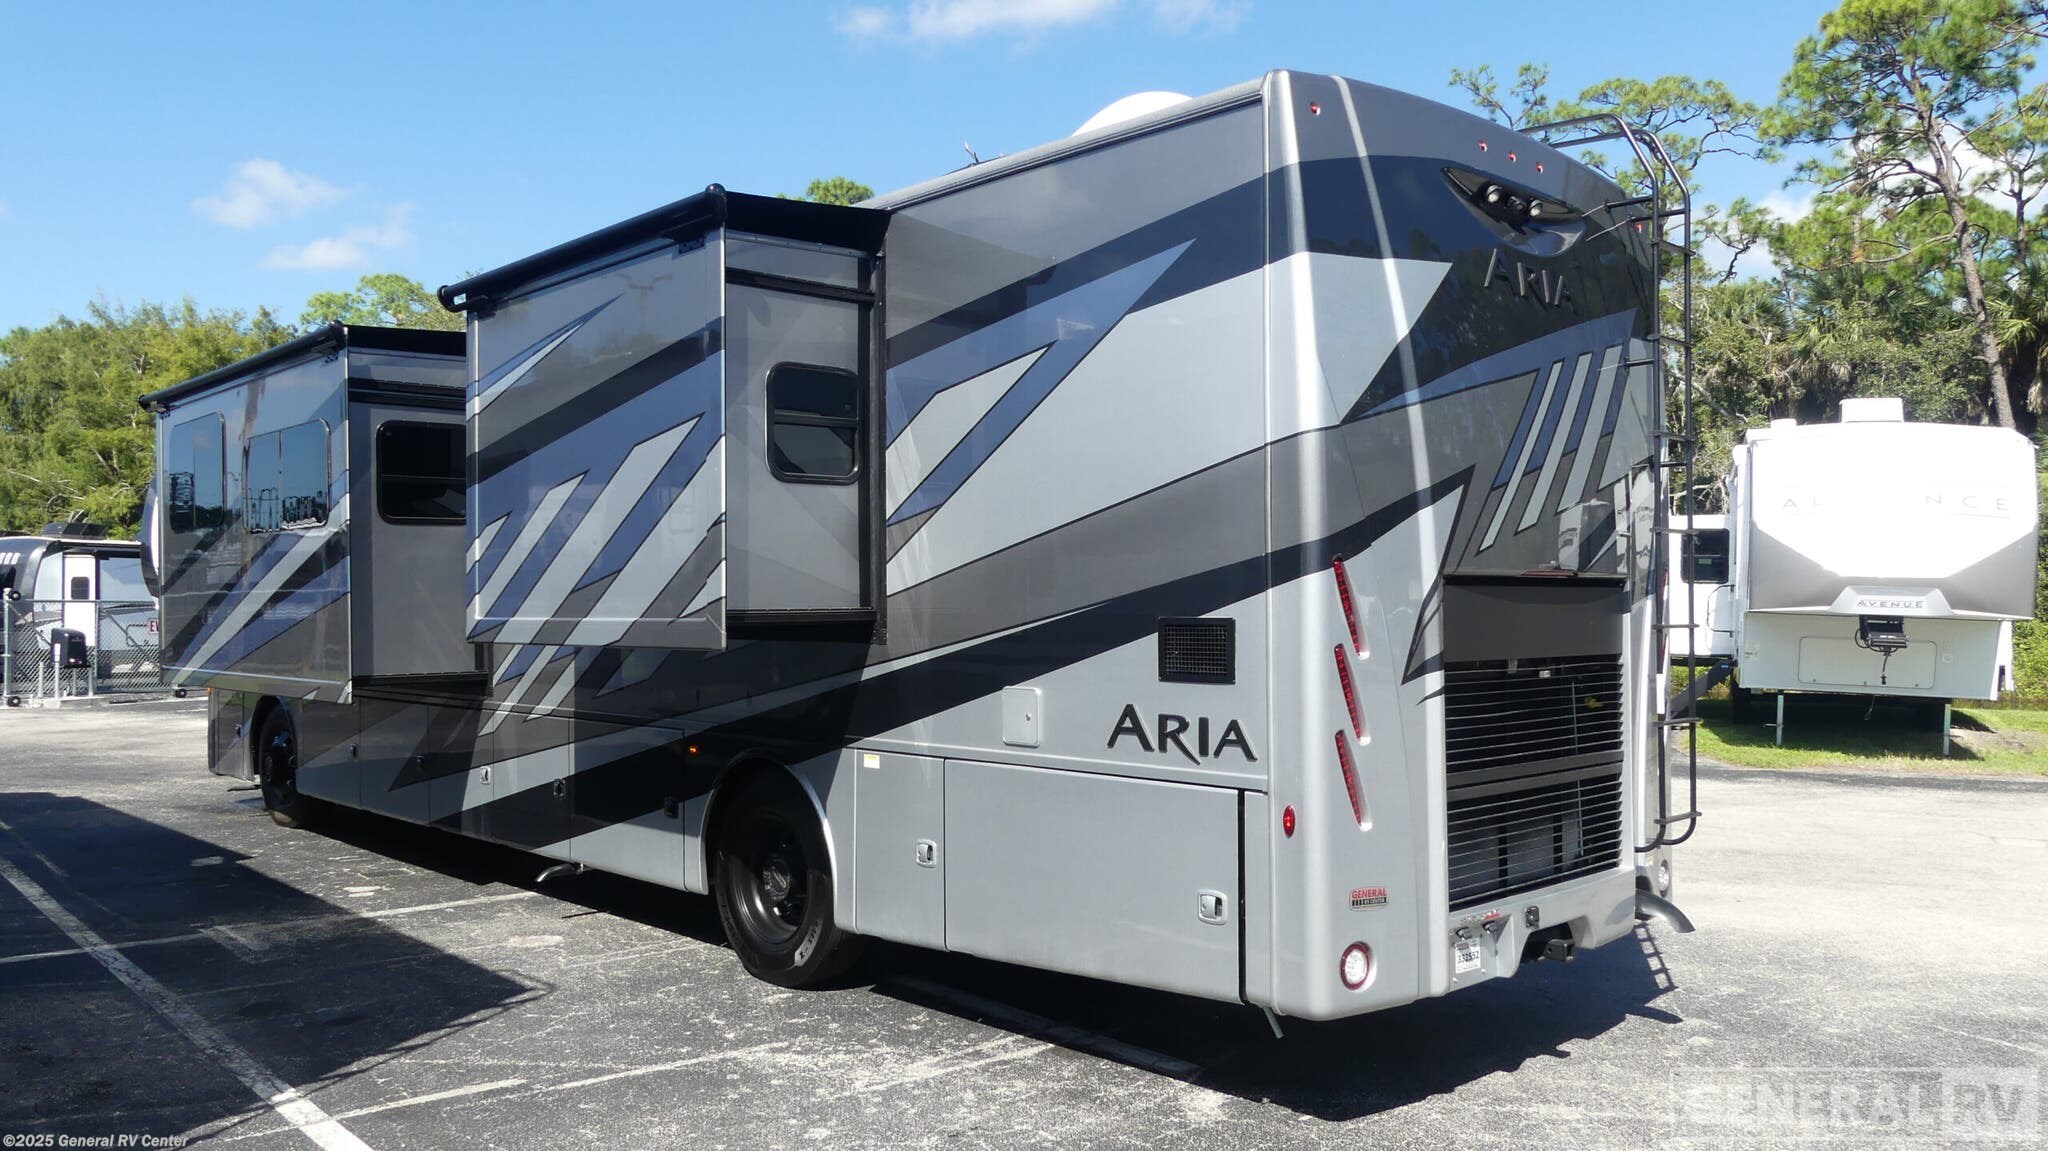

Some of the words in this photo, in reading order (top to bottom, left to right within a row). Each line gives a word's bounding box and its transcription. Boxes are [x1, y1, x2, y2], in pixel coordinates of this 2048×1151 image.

[1484, 248, 1577, 316] ARIA
[1782, 493, 2009, 511] ALNCE
[1857, 600, 1925, 609] AVENUE
[1107, 703, 1258, 765] ARIA
[1352, 888, 1387, 899] GENERAL
